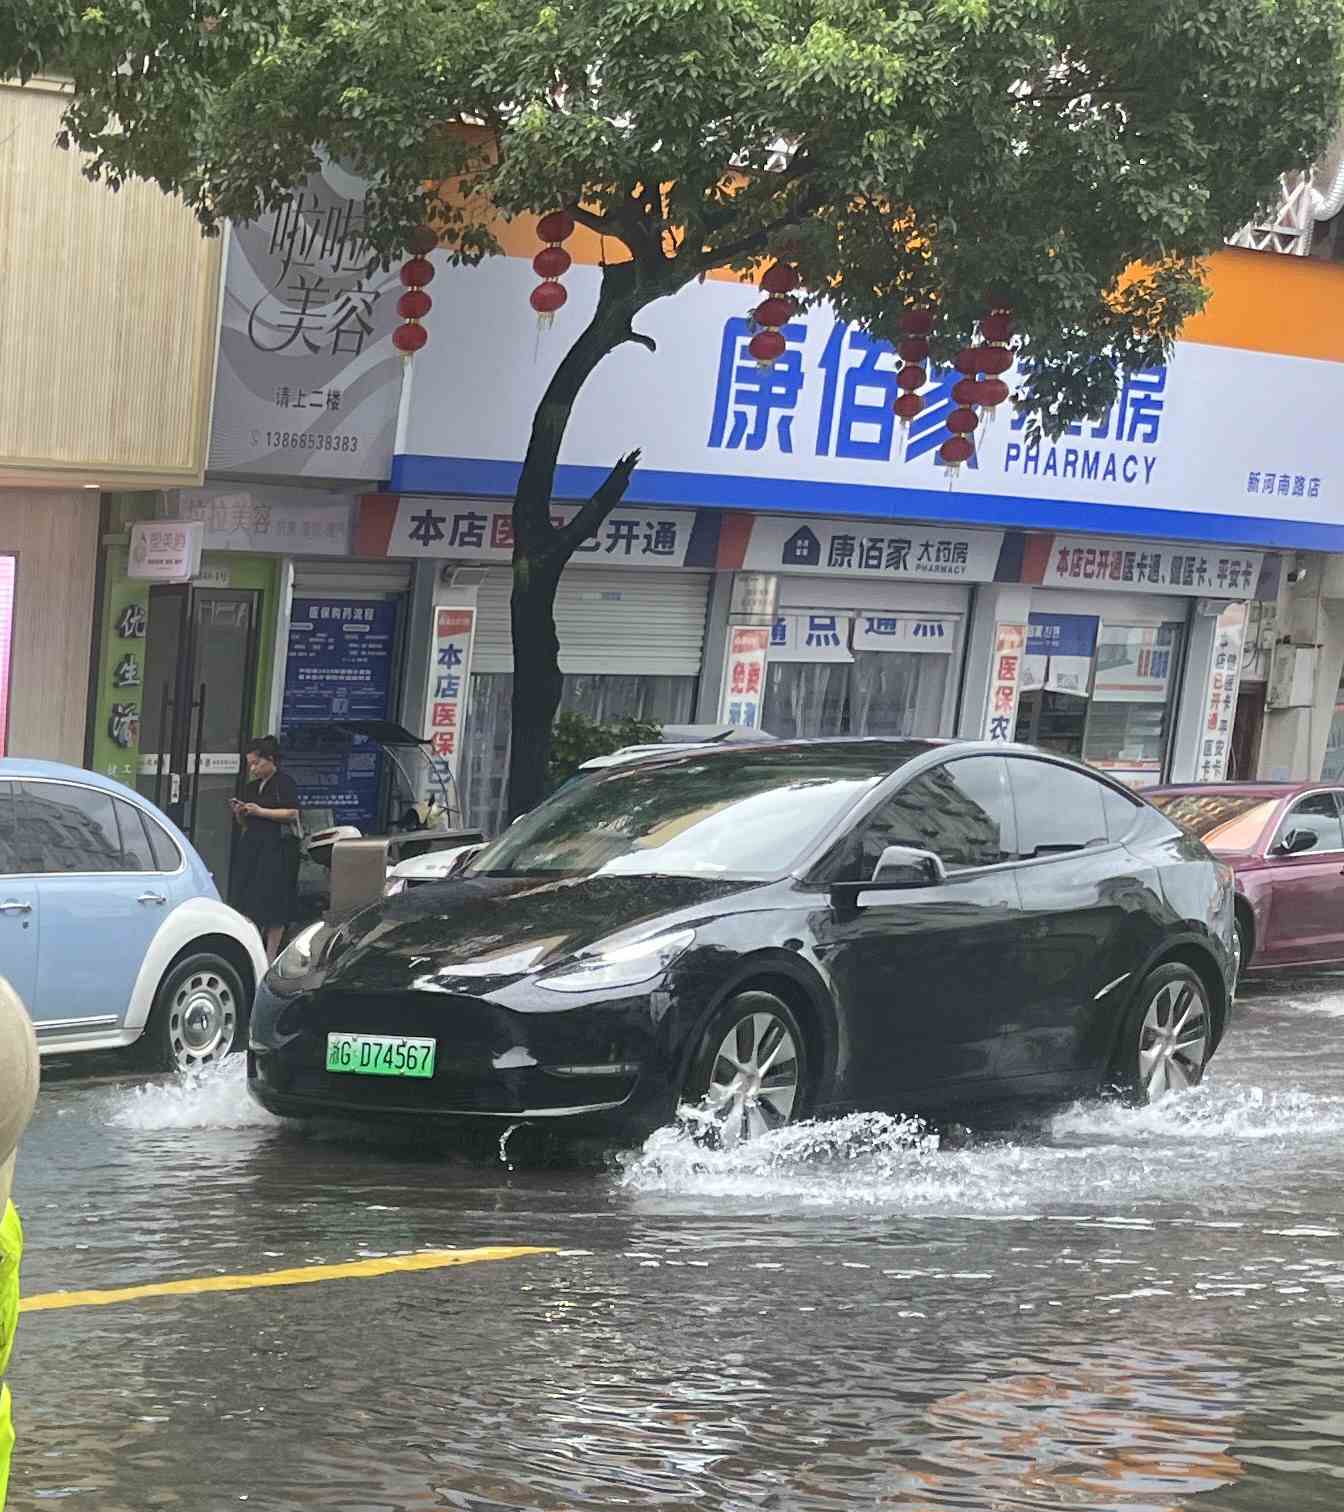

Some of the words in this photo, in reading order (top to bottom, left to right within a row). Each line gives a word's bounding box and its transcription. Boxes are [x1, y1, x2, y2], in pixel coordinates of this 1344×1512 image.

[249, 274, 381, 356] 美容
[274, 386, 341, 411] 请上二楼
[265, 431, 359, 453] 13868538383
[1003, 442, 1159, 485] PHARMACY
[1247, 471, 1321, 497] 新河南路店
[409, 509, 677, 555] 本店医开通
[826, 534, 912, 571] 康佰家
[917, 540, 969, 564] 大药房
[914, 564, 967, 576] PHARMACY
[360, 1042, 431, 1071] D74567
